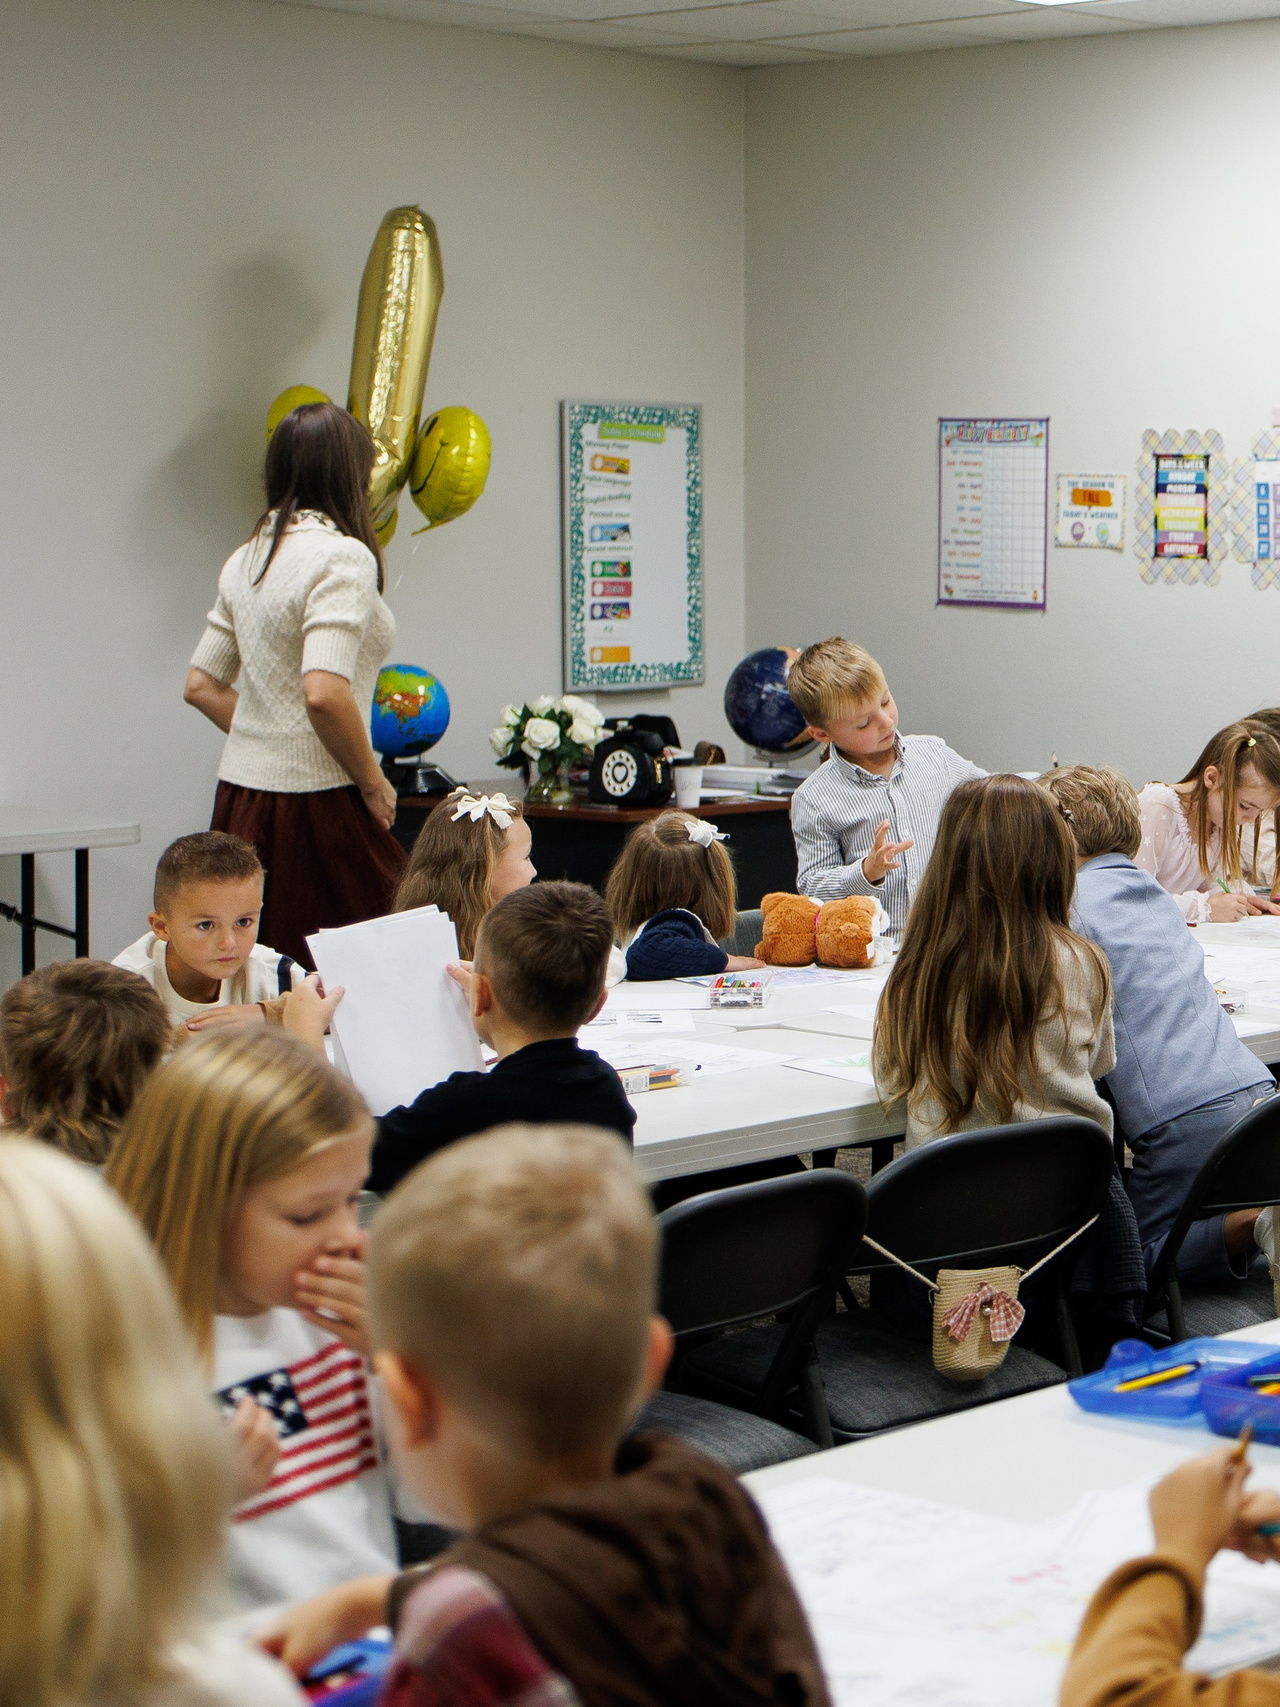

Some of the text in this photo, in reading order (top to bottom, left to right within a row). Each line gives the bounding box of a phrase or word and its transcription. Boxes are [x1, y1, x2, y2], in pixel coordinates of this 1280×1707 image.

[629, 429, 664, 440] Schedule
[958, 426, 1029, 442] HAPPY BIRTHDAY
